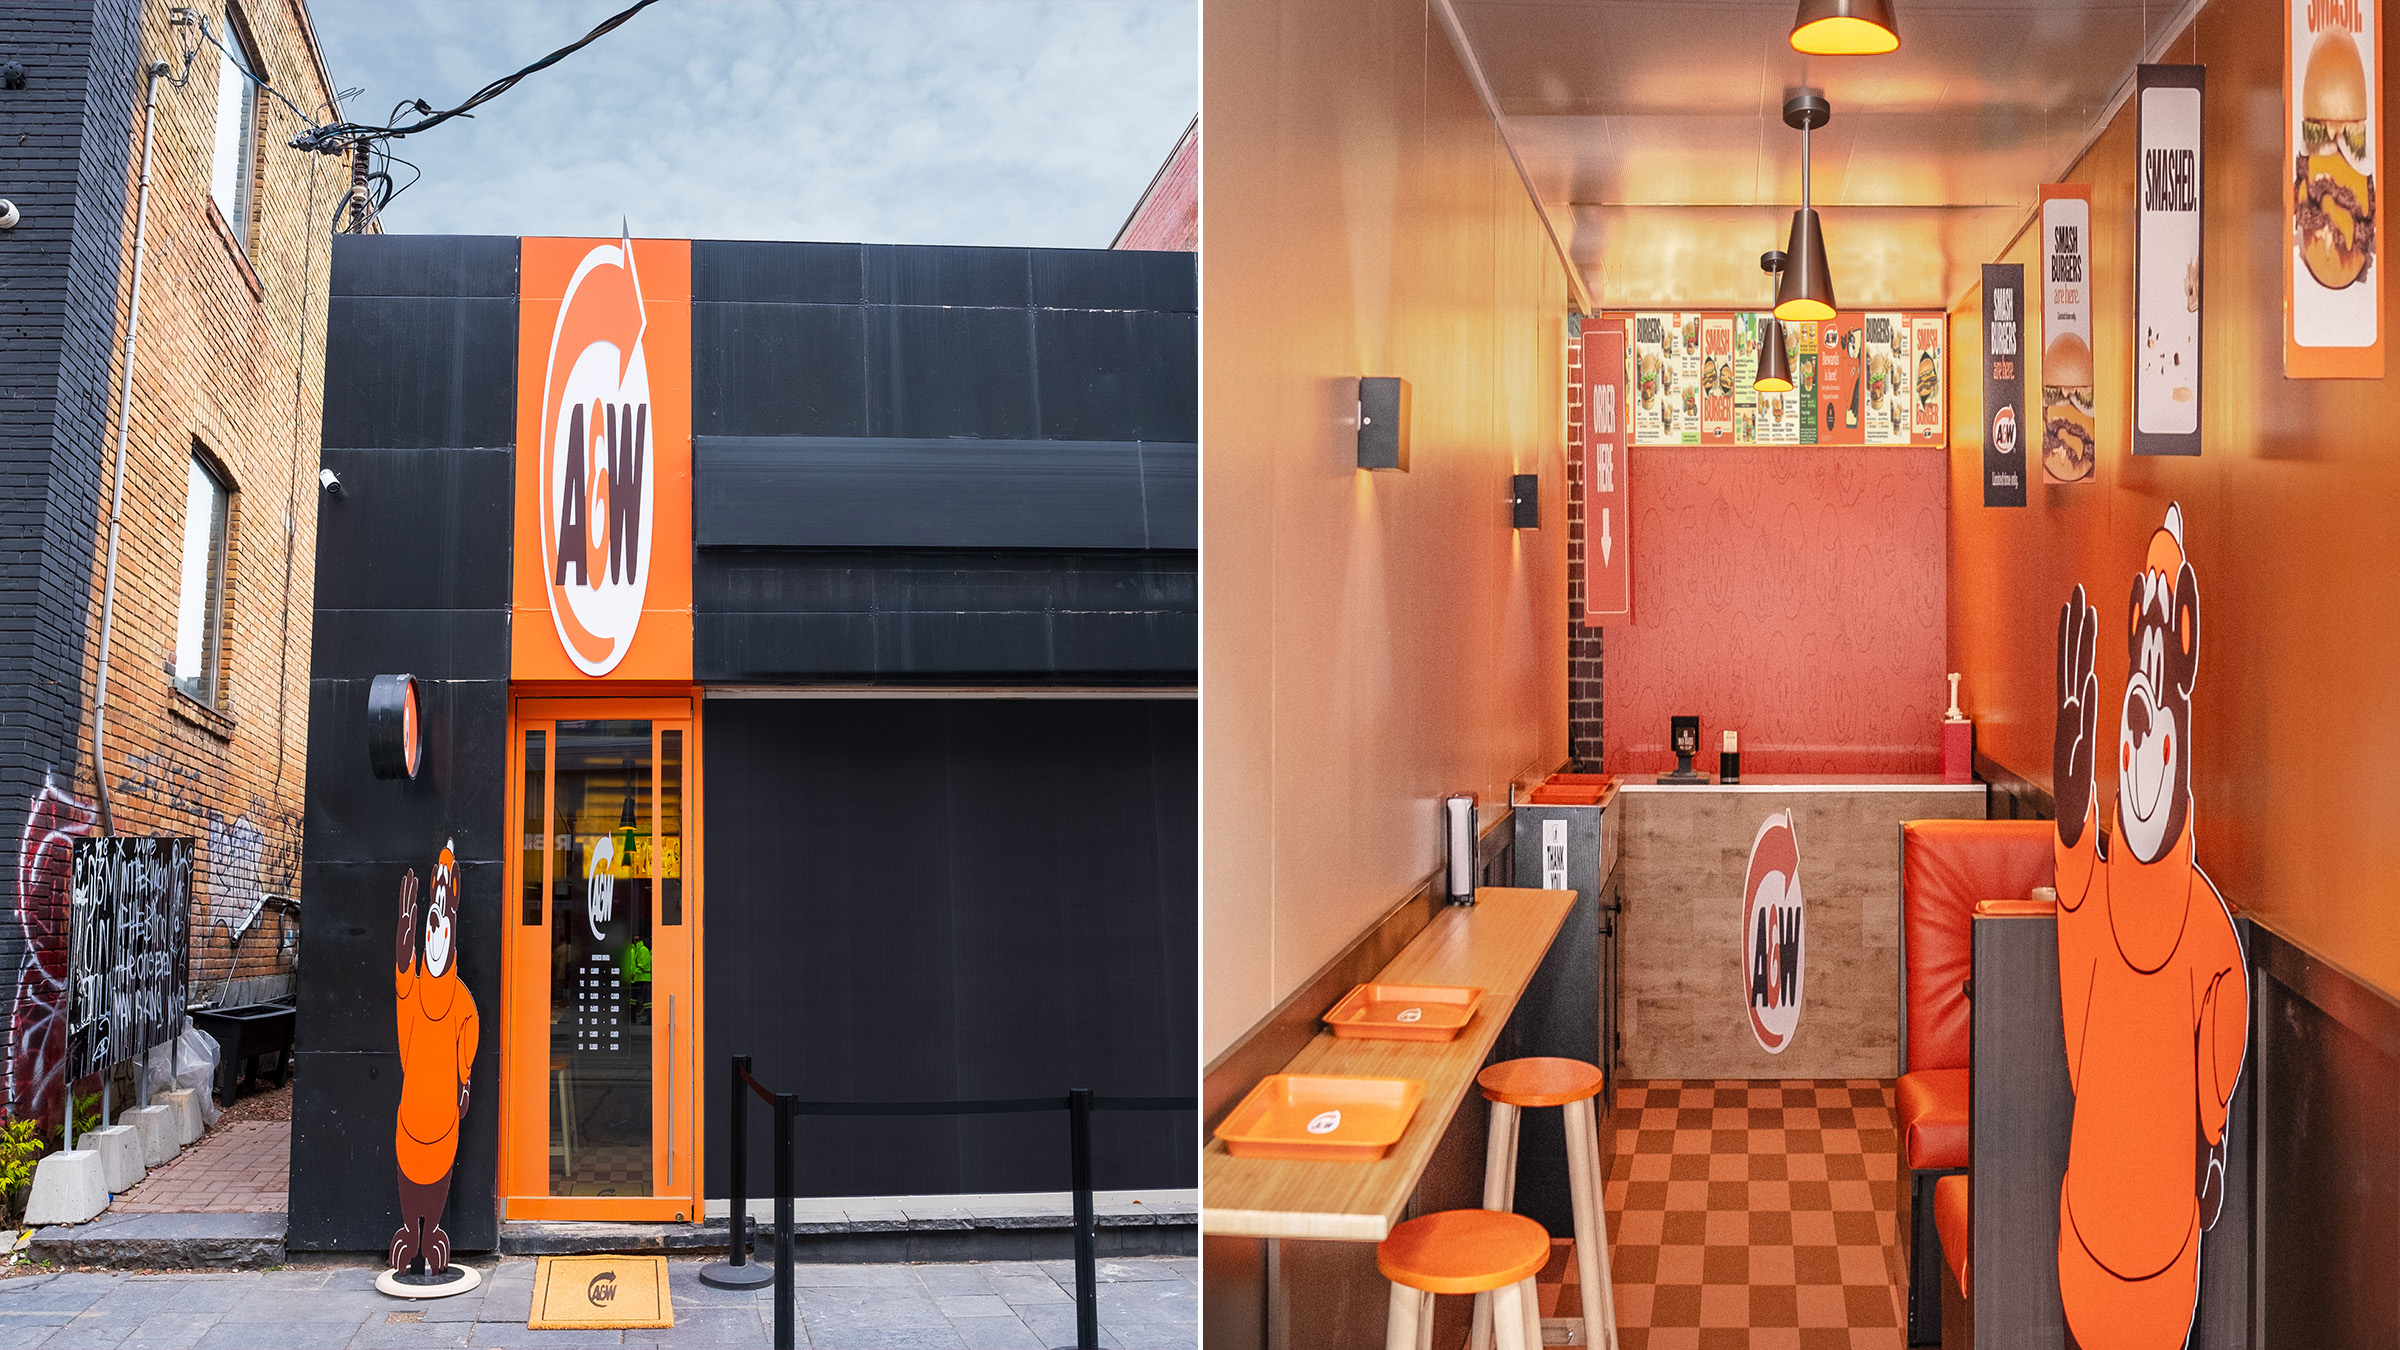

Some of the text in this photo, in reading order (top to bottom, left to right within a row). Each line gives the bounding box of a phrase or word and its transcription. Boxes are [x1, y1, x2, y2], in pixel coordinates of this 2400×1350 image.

[2145, 148, 2197, 212] SMASHED.
[2054, 226, 2078, 254] SMASH
[2051, 255, 2082, 283] BURGERS
[1993, 288, 2013, 321] SMASH
[2054, 288, 2064, 304] are
[1637, 318, 1661, 343] BURGERS
[1705, 328, 1730, 355] SMASH
[1866, 318, 1890, 343] BURGERS
[1916, 328, 1938, 351] SMASH
[1991, 321, 2017, 355] BURGERS
[1822, 351, 1840, 366] Rewards
[1993, 361, 2002, 379] are
[1593, 384, 1616, 433] ORDER
[1704, 395, 1731, 422] BURGER
[1996, 424, 2015, 444] A&W
[1596, 443, 1615, 492] HERE
[555, 397, 647, 591] A&W
[1547, 845, 1565, 871] THANK
[590, 872, 615, 923] A&W
[1751, 903, 1801, 1010] A&W
[592, 1284, 618, 1301] A&W
